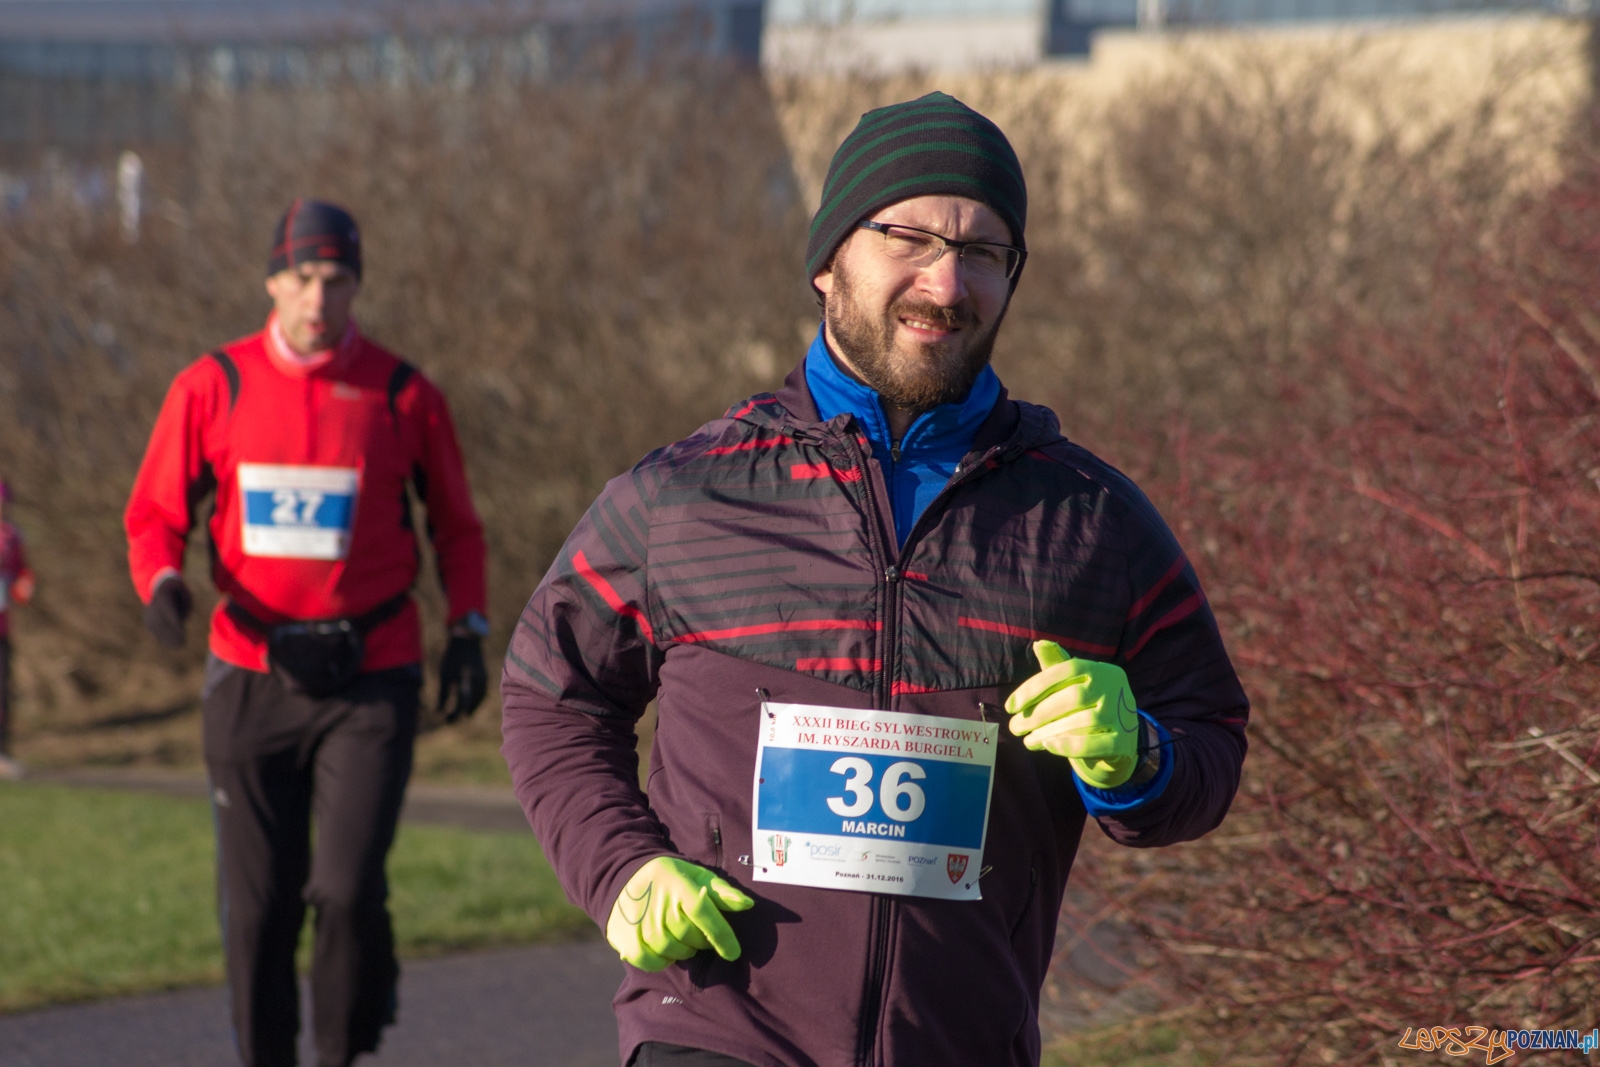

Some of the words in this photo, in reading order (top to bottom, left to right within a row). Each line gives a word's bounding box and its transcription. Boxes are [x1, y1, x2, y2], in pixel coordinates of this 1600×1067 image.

[271, 488, 325, 525] 27
[792, 715, 832, 729] XXXII
[836, 718, 871, 732] BIEG
[874, 721, 983, 743] SYLWESTROWY
[797, 732, 819, 745] IM.
[823, 734, 901, 751] RYSZARDA
[904, 741, 974, 759] BURGIELA
[826, 756, 927, 822] 36
[841, 820, 906, 838] MARCIN
[835, 871, 861, 879] Poznań
[866, 873, 904, 883] 31.12.2016
